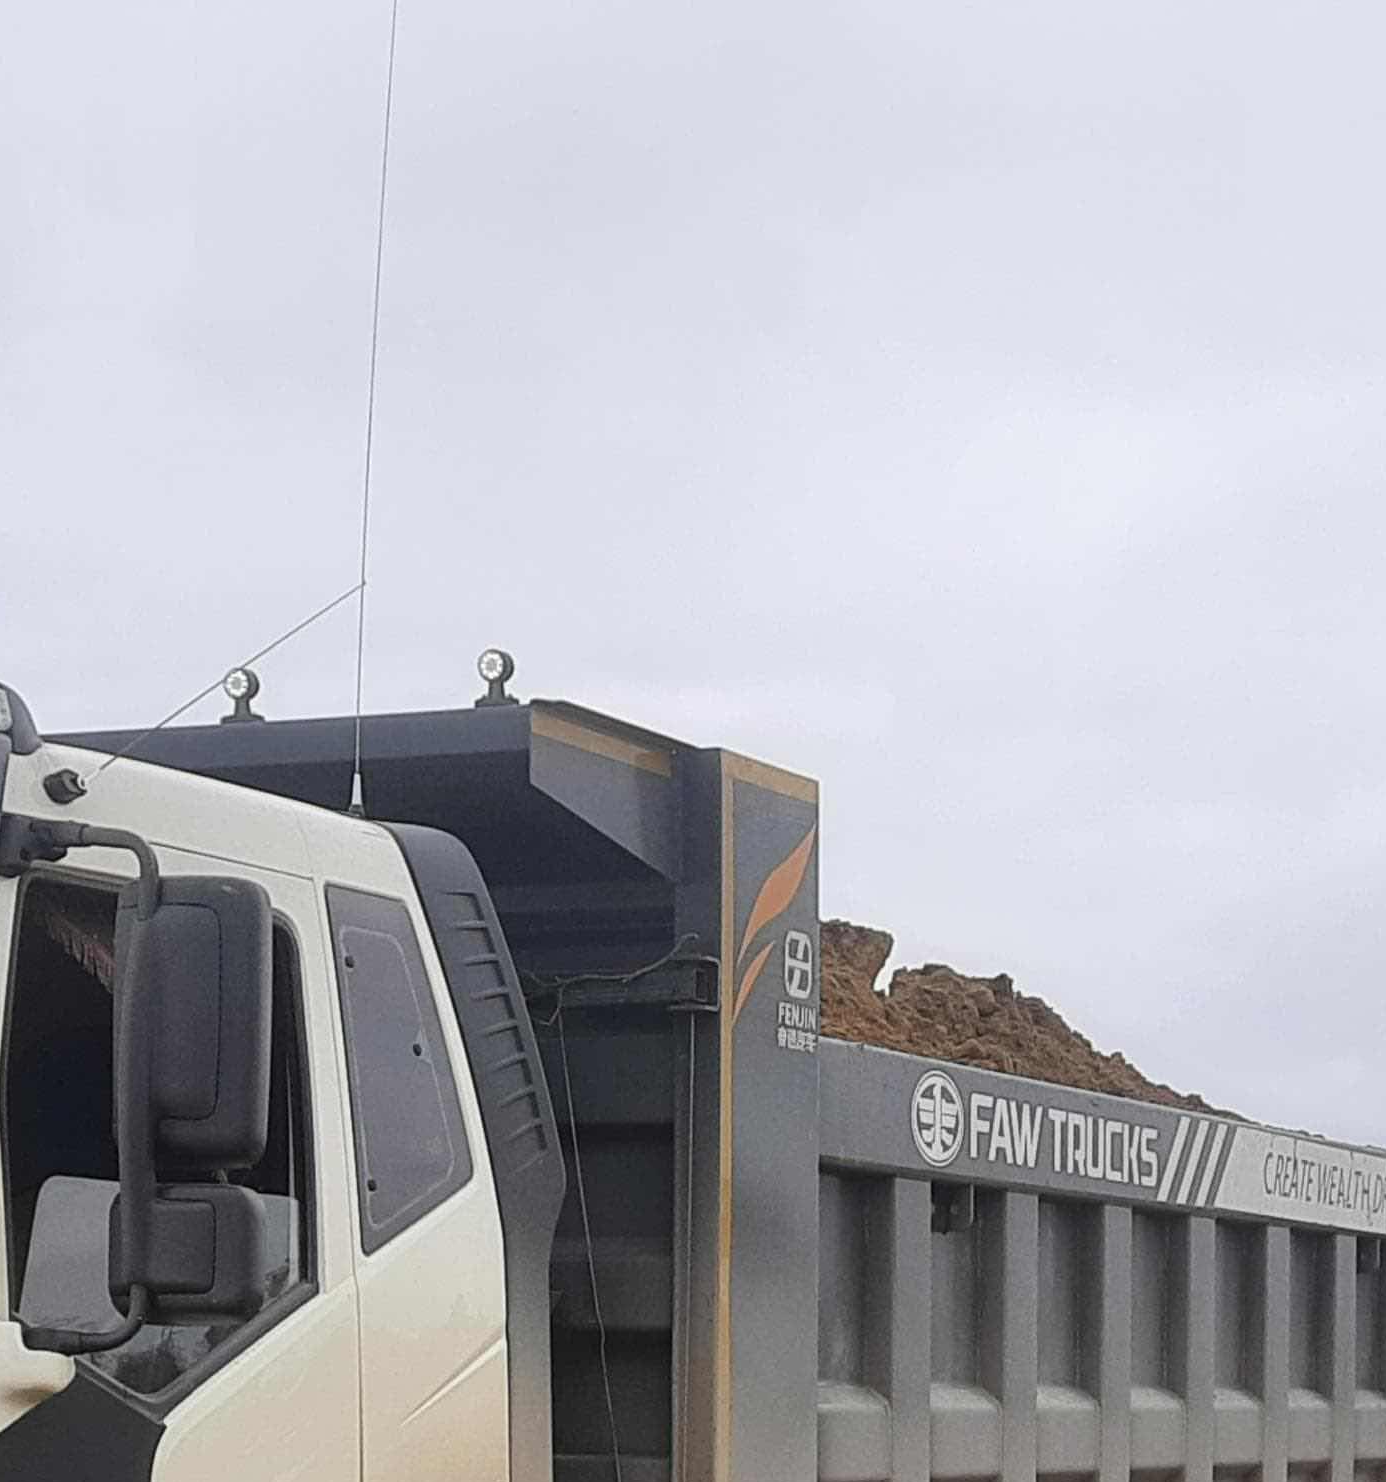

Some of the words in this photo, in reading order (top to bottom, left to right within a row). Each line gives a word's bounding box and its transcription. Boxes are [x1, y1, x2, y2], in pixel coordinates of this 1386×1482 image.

[778, 1002, 816, 1030] FENJIN
[969, 1092, 1043, 1168] FAW
[1048, 1108, 1158, 1187] TRUCKS
[1264, 1152, 1315, 1202] CREATE
